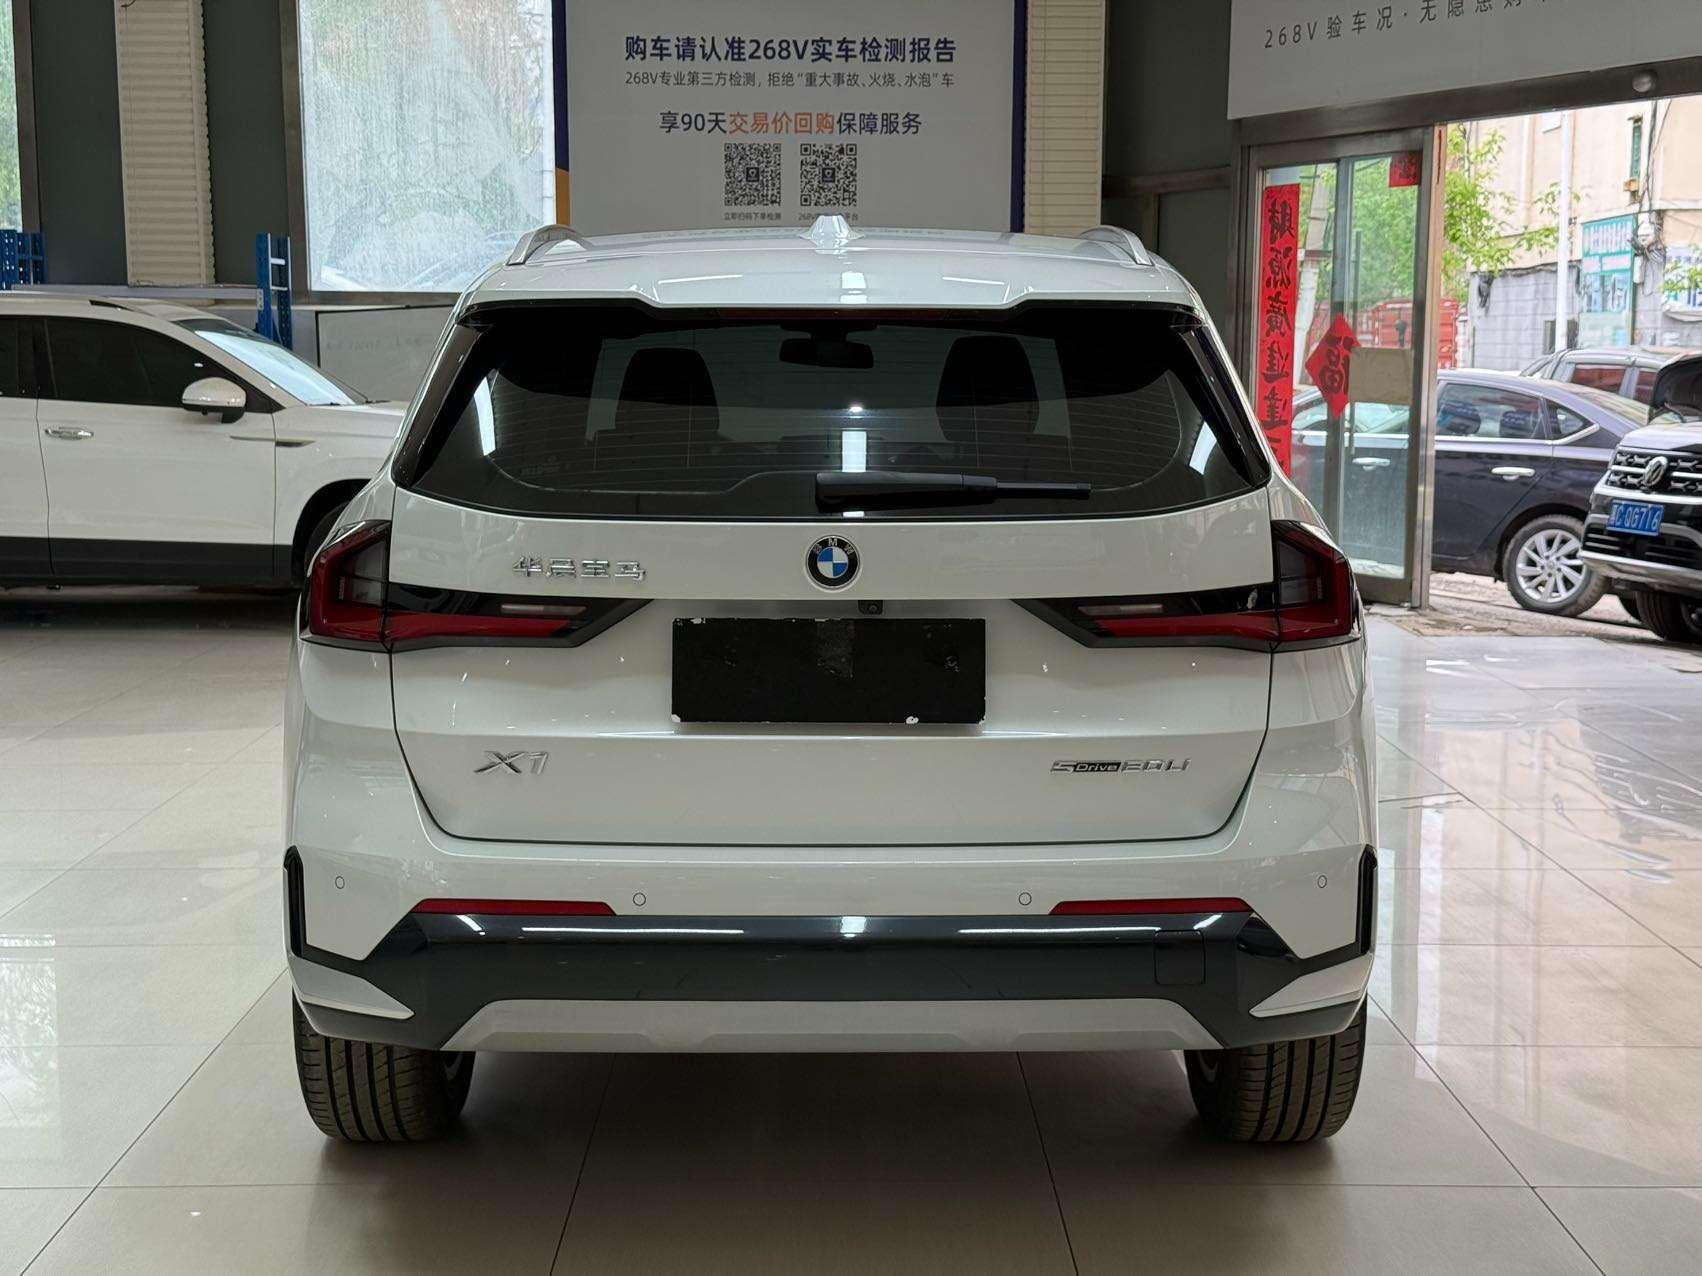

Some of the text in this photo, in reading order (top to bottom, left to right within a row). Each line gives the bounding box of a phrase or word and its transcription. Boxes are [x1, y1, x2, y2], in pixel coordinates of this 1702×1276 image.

[624, 35, 956, 63] 购车请认准268V实车检测报告
[659, 111, 922, 135] 享90天交易价回购保障服务
[473, 751, 549, 775] X1
